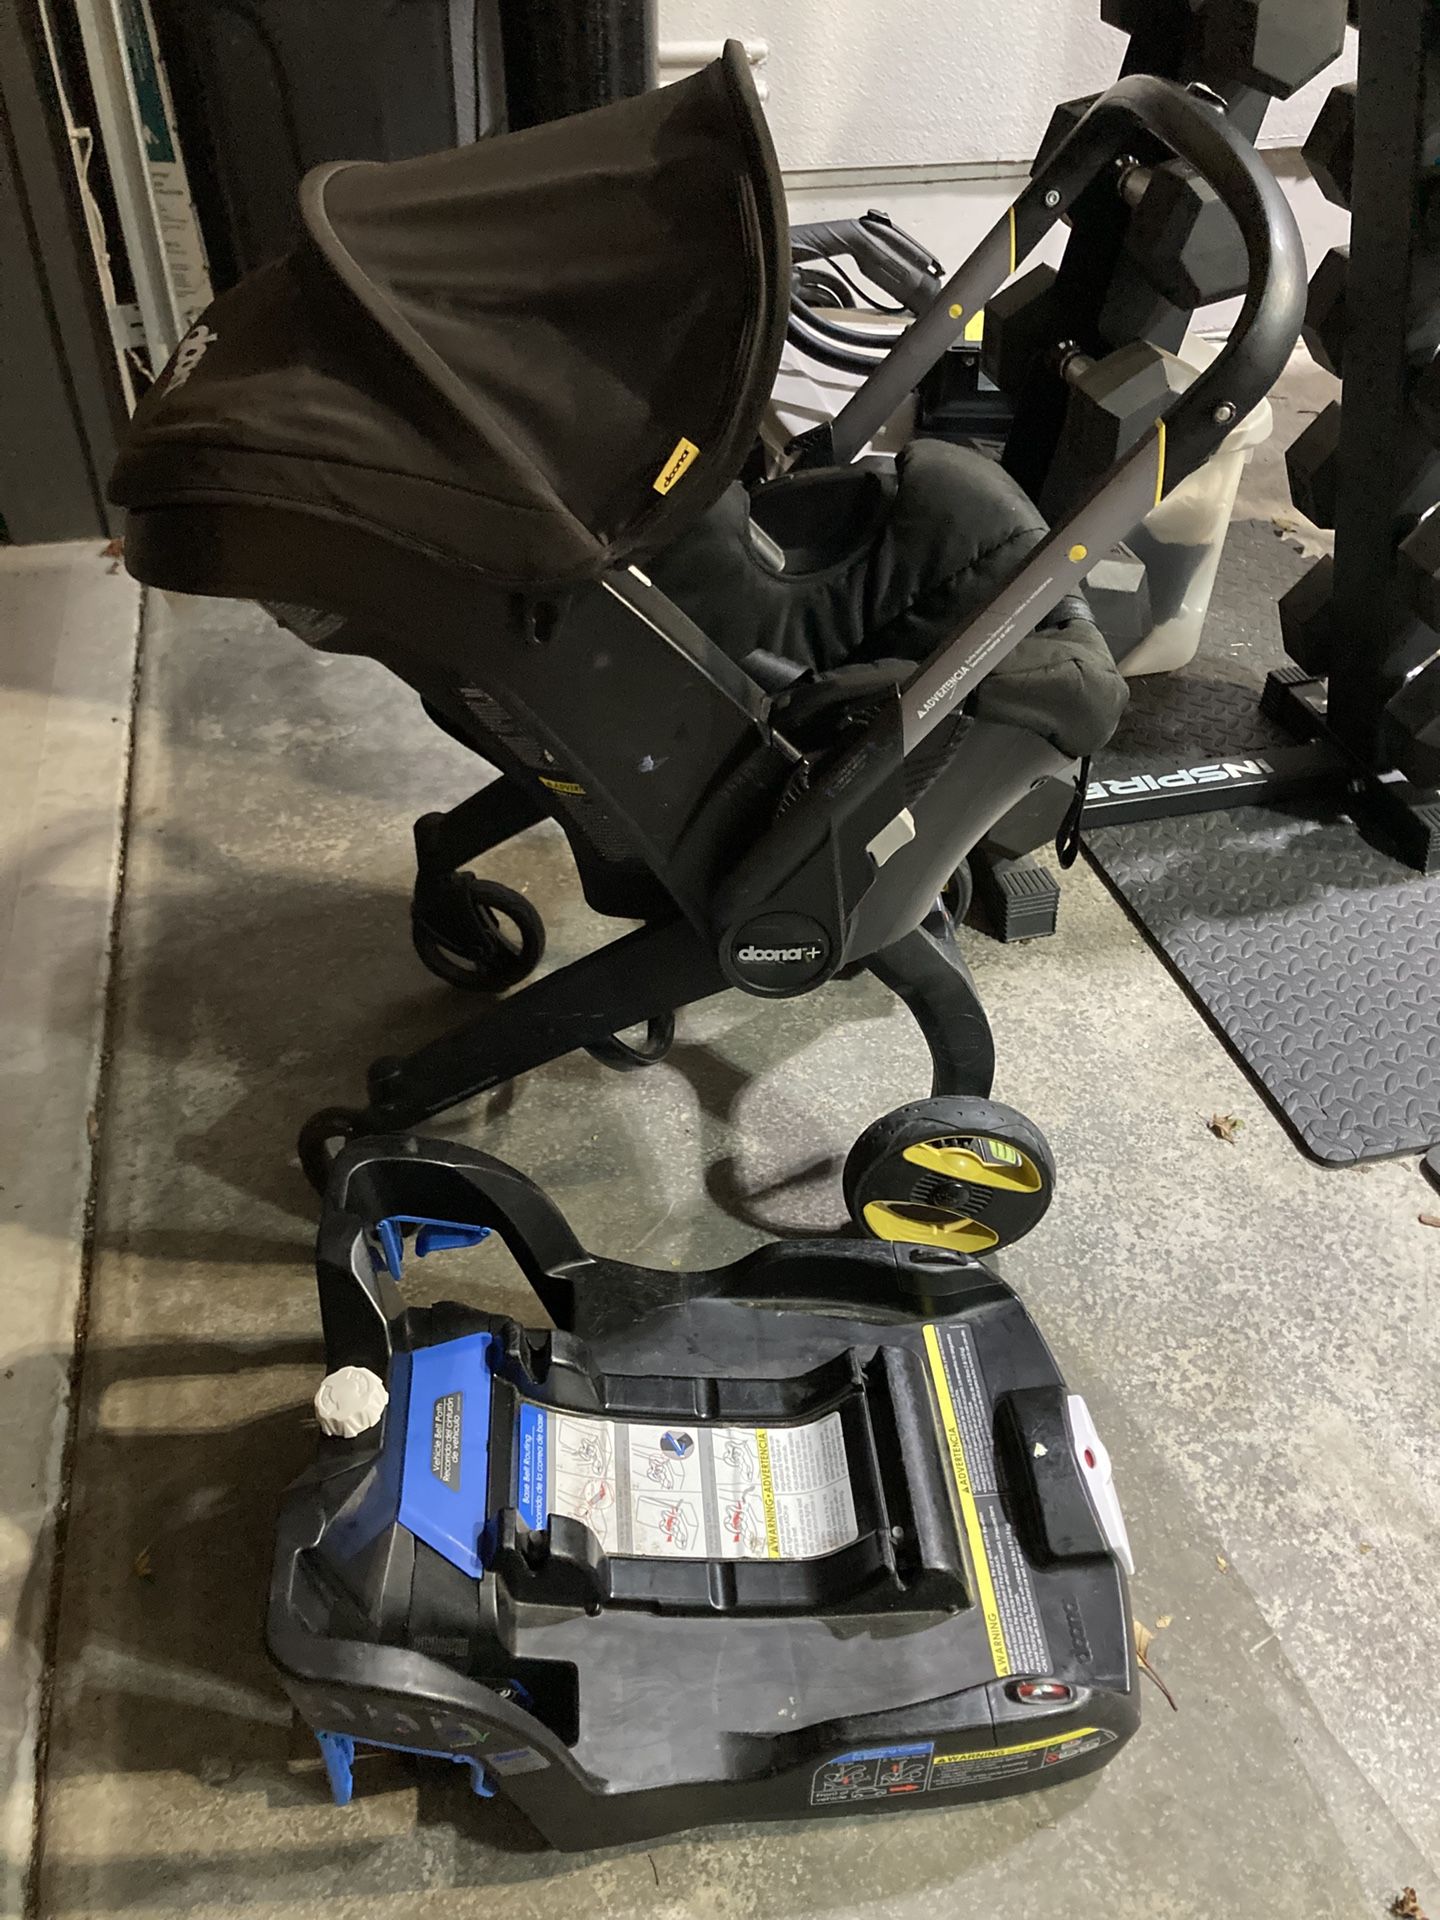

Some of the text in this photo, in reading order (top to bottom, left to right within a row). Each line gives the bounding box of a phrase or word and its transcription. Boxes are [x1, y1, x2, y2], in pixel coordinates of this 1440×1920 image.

[664, 450, 689, 488] doona
[1085, 758, 1274, 800] INSPIRE
[433, 1403, 443, 1472] Vehicle Belt Path
[536, 1413, 544, 1433] base
[536, 1434, 544, 1445] de
[443, 1444, 452, 1482] Recorrido
[452, 1450, 459, 1463] de
[522, 1434, 532, 1504] Base Belt Routing
[948, 1427, 968, 1486] ADVERTENCIA
[536, 1472, 543, 1482] la
[536, 1482, 543, 1494] de
[758, 1433, 778, 1545] WARNING ADVERTENCIA
[536, 1495, 544, 1531] ecorrido
[988, 1613, 1006, 1665] WARNING
[948, 1750, 1006, 1762] WARNING
